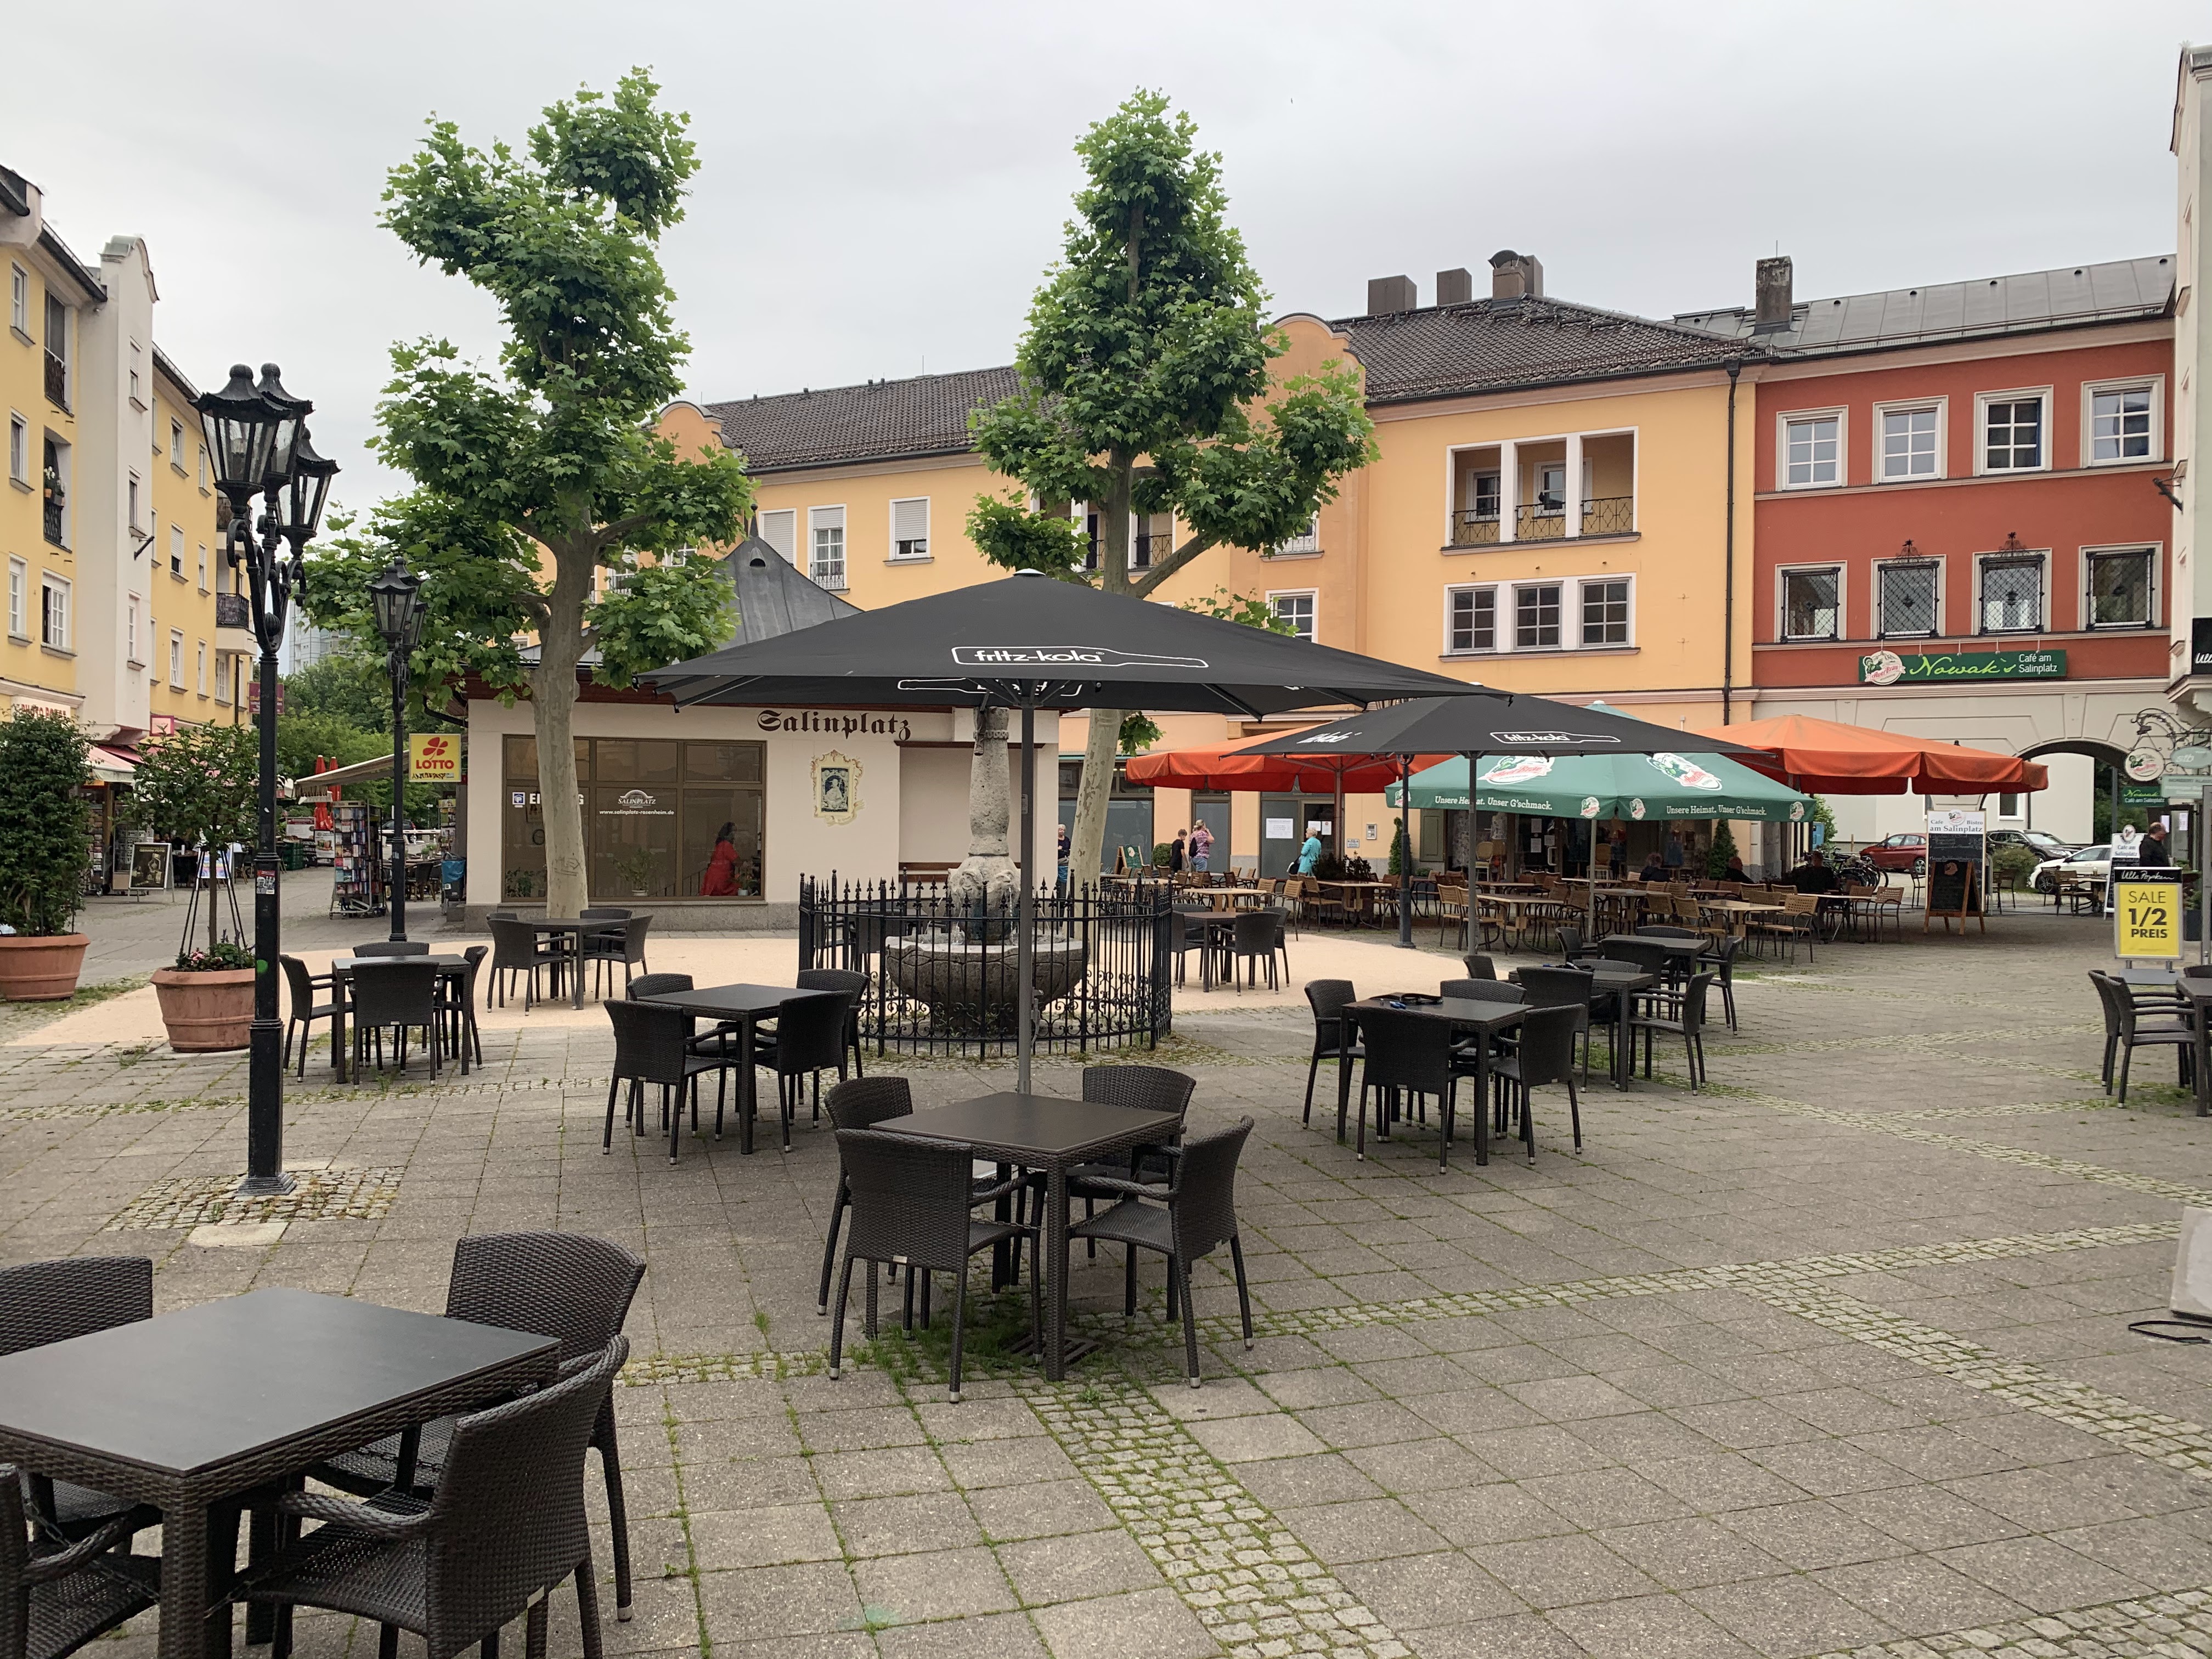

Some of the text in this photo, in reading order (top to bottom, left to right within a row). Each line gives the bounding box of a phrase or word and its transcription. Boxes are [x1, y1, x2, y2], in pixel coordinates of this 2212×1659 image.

[2019, 653, 2037, 662] Café
[2019, 663, 2057, 675] Salinplatz
[757, 709, 911, 741] Salinplatz
[416, 760, 454, 769] LOTTO
[1487, 797, 1509, 806] Unser
[1510, 799, 1552, 810] G'schmack.
[1667, 805, 1767, 815] Unsere Heimat. Unser G'schmack.
[2129, 891, 2166, 903] SALE
[2129, 907, 2168, 927] 1/2
[2131, 928, 2168, 939] PREIS
